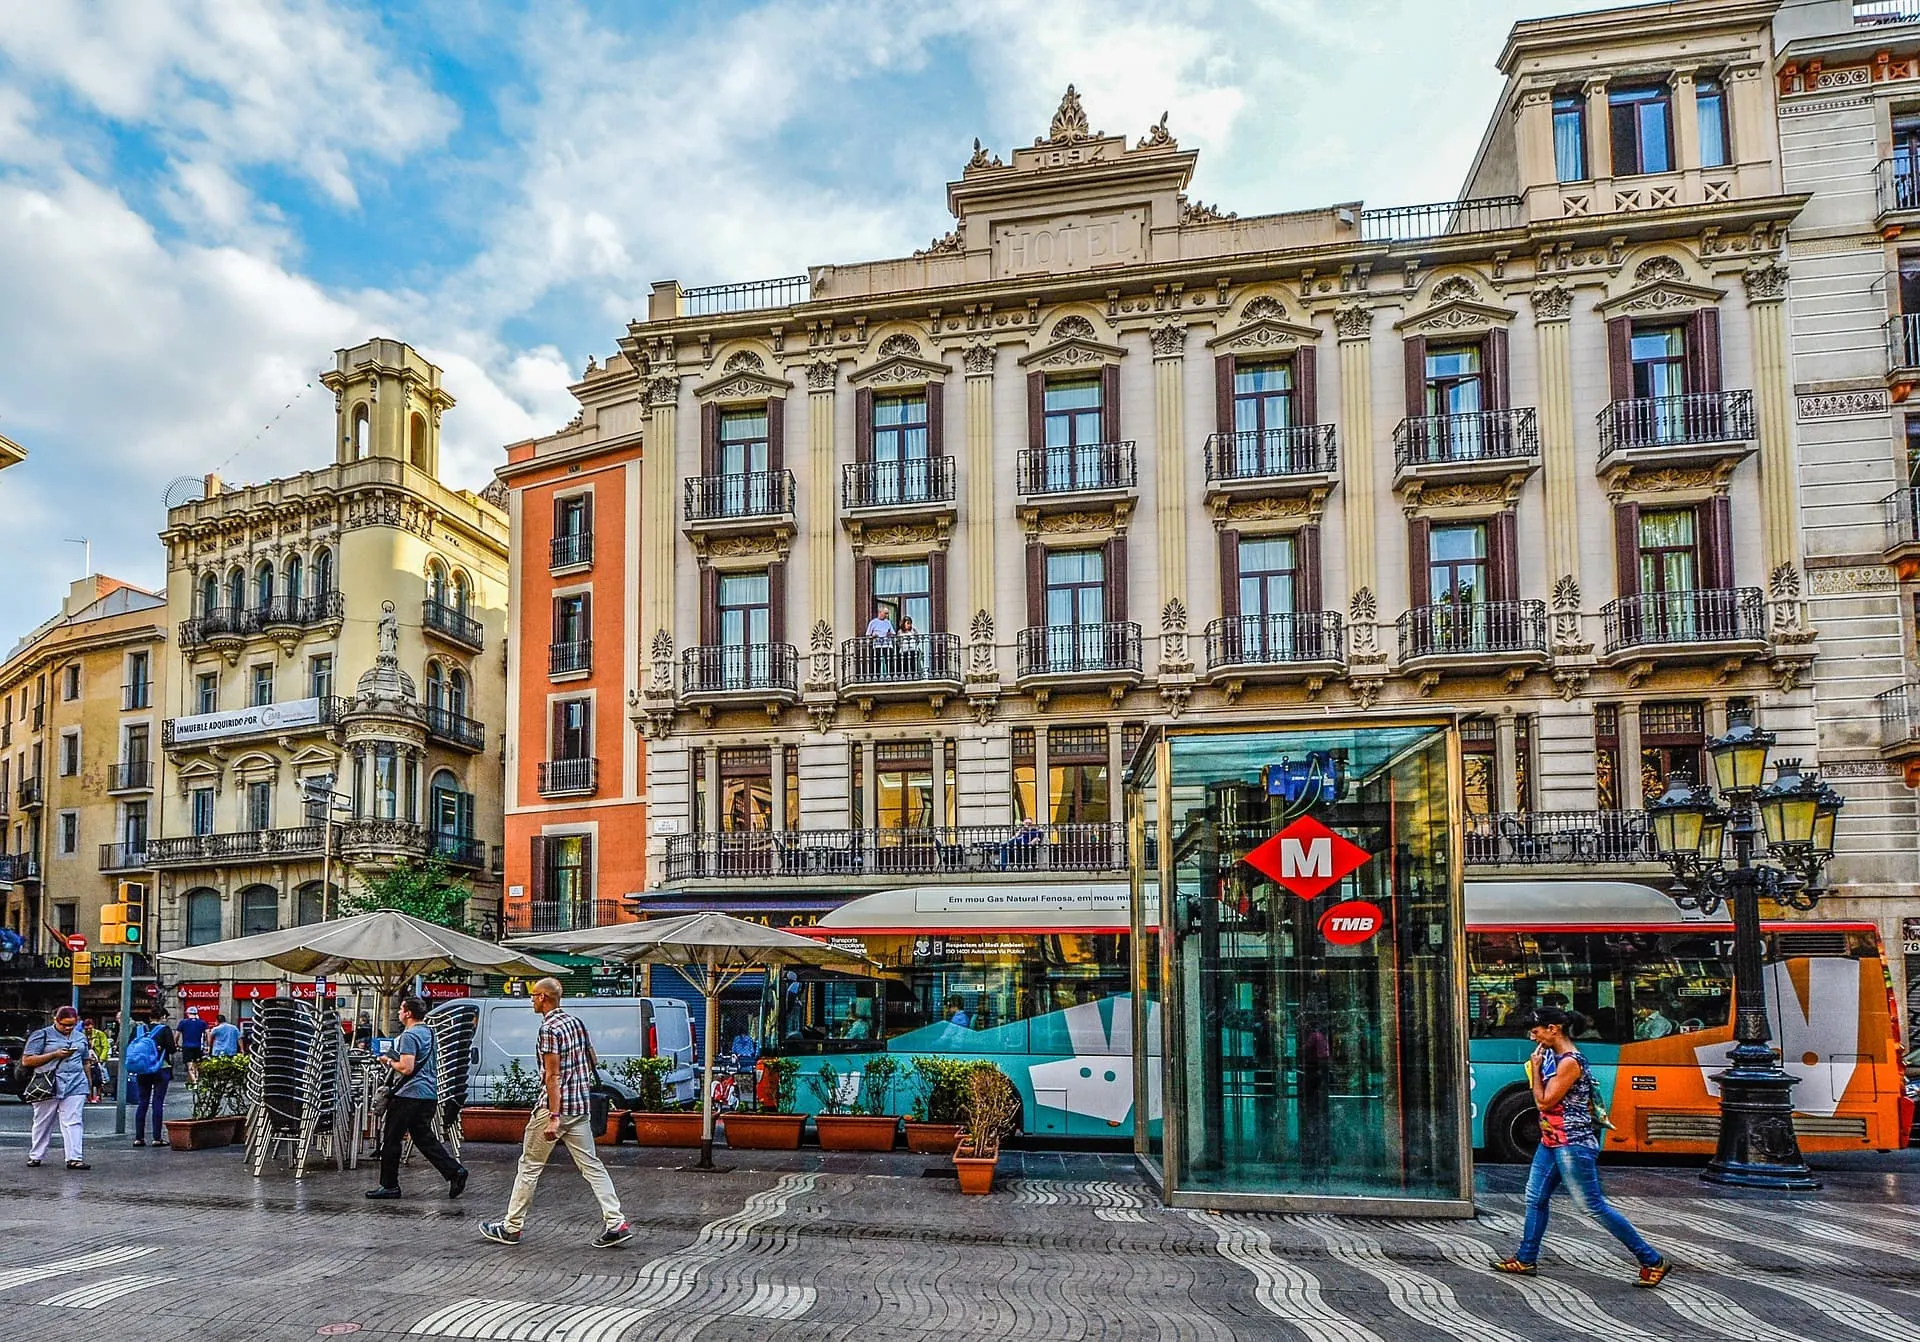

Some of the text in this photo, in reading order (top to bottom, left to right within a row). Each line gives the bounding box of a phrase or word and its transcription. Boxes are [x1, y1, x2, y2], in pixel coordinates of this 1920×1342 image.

[1035, 146, 1105, 169] 1894
[1005, 221, 1131, 269] HOTEL
[177, 722, 208, 734] INMUEBLE
[209, 718, 243, 730] ADQUIRIDO
[244, 716, 257, 726] POR
[1281, 837, 1332, 878] M
[1006, 895, 1039, 903] Natural
[1041, 895, 1075, 903] Fenosa,
[1331, 918, 1373, 931] TMB
[1903, 943, 1919, 951] 76
[188, 988, 219, 998] Santander
[432, 988, 464, 998] Santander
